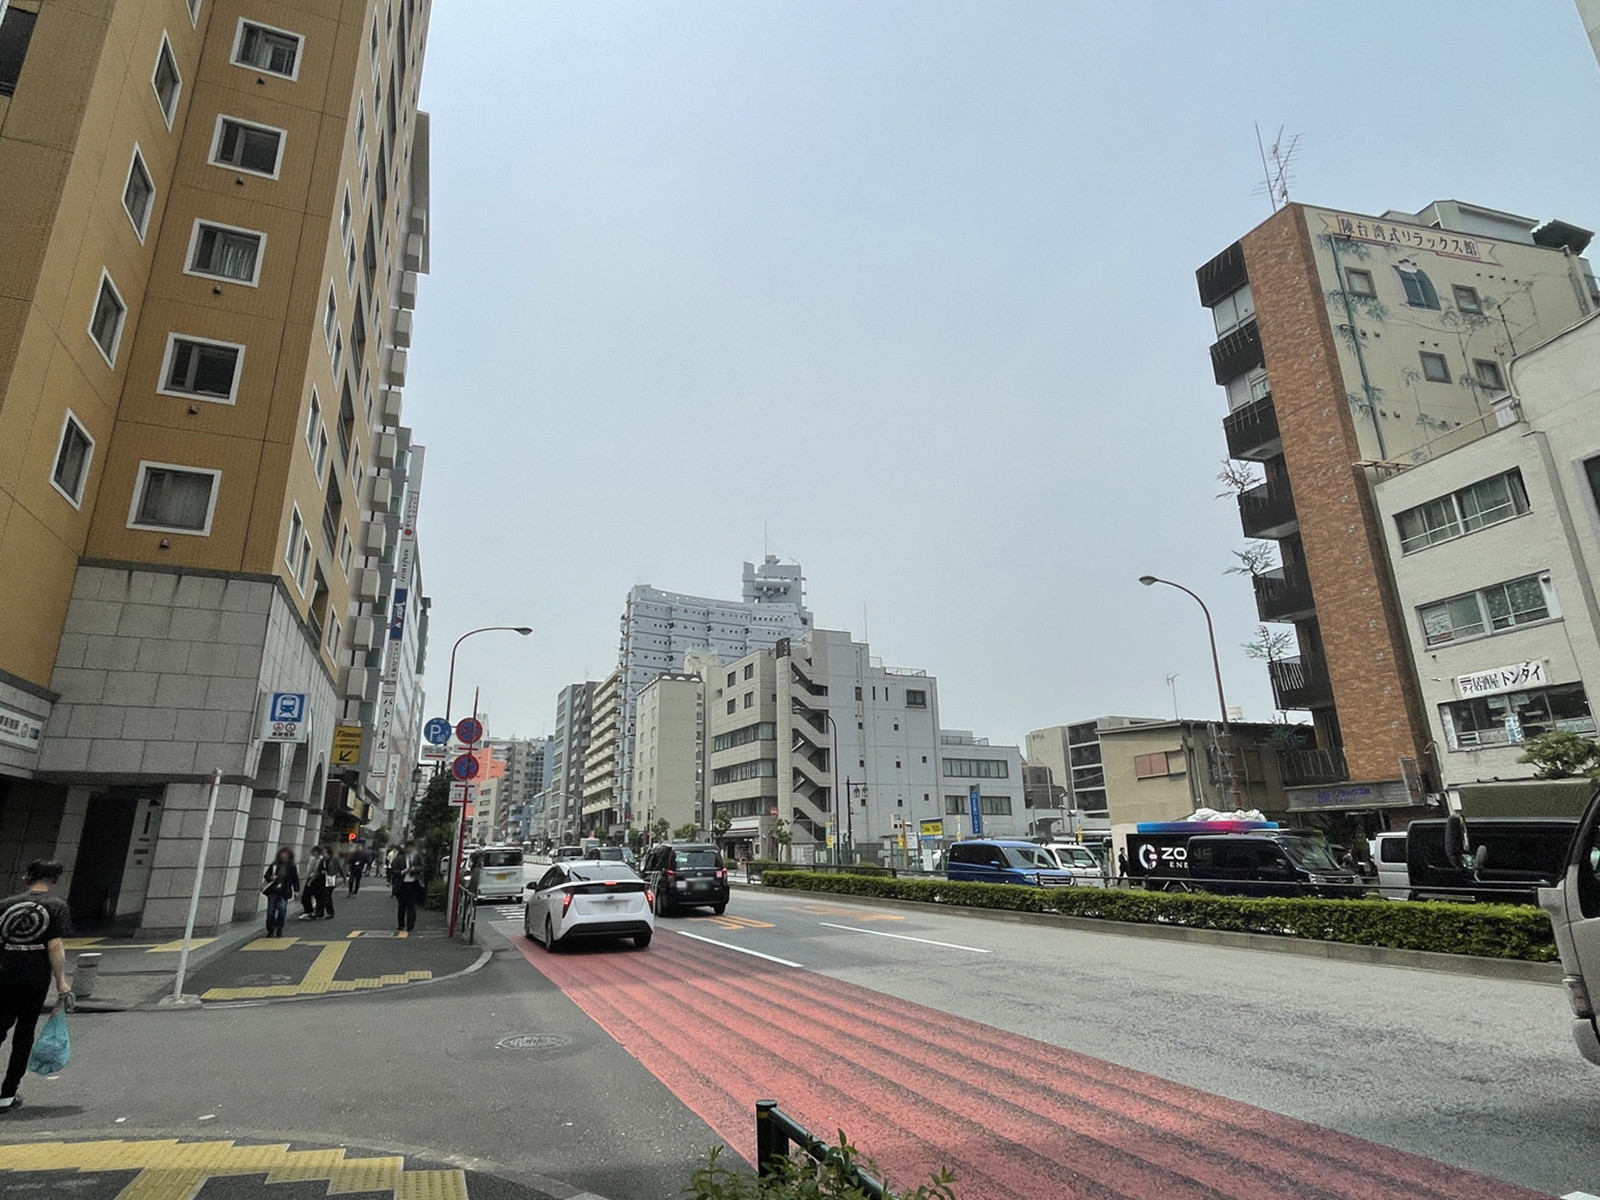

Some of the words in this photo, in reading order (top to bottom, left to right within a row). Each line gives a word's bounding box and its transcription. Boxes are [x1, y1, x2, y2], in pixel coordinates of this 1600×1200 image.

[377, 698, 393, 750] バトゥール
[429, 724, 442, 742] P
